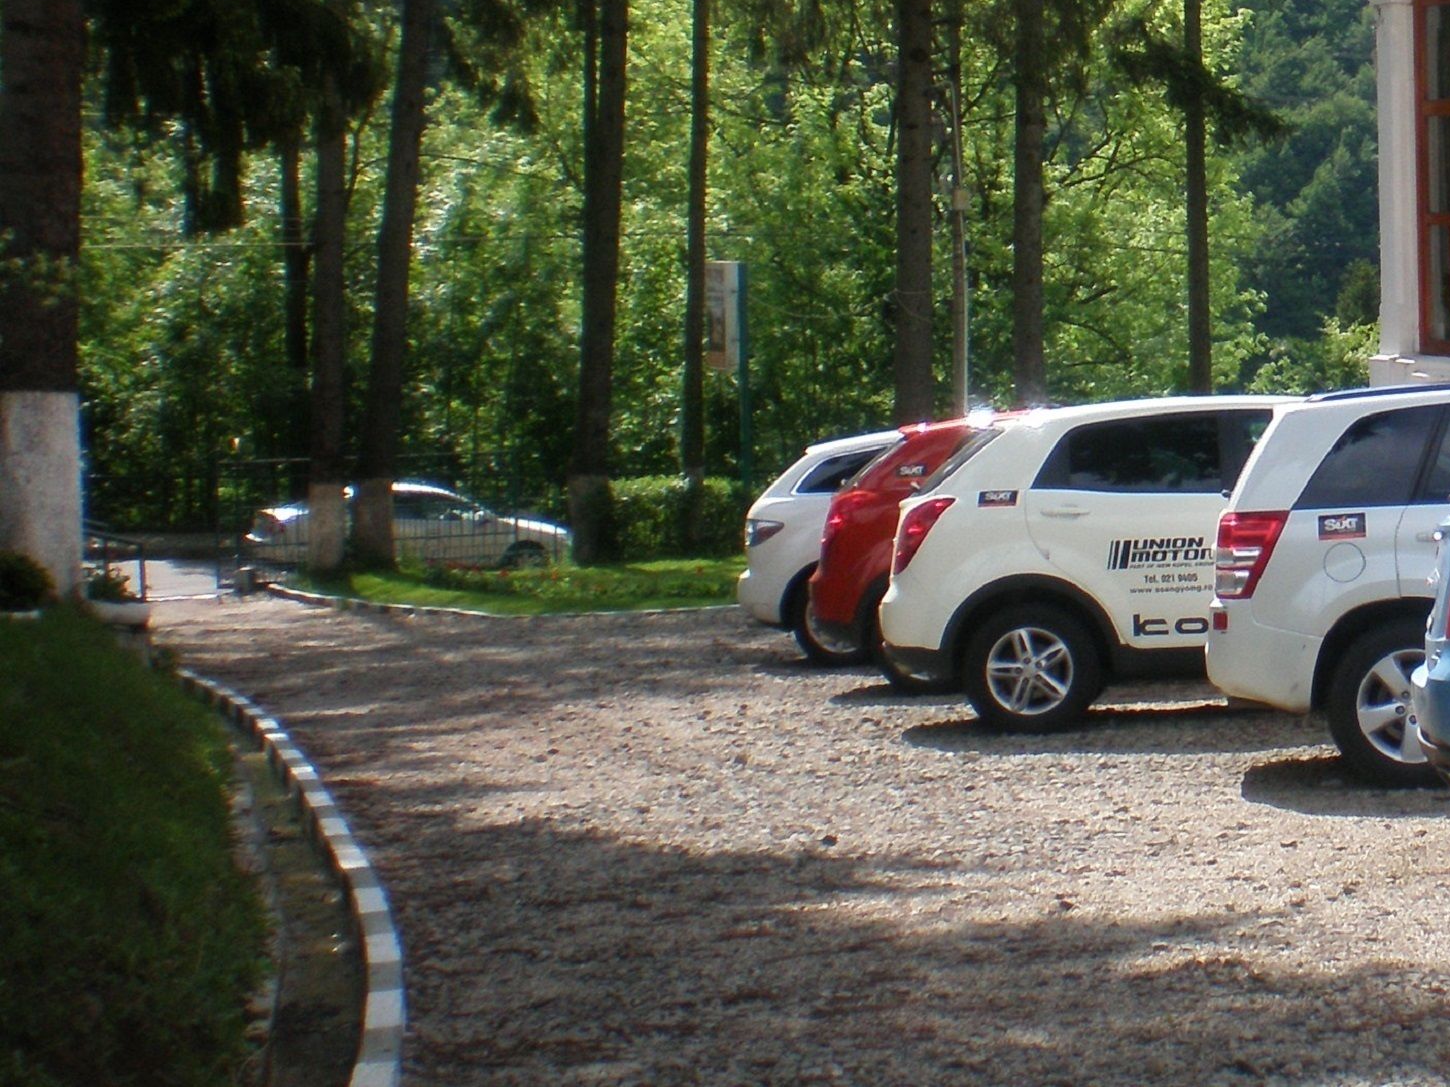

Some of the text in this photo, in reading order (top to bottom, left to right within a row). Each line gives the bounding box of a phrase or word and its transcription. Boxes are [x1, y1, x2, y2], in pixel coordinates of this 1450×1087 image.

[1133, 537, 1204, 550] UNION
[1131, 548, 1214, 562] MOTOR
[1133, 614, 1209, 637] ko
